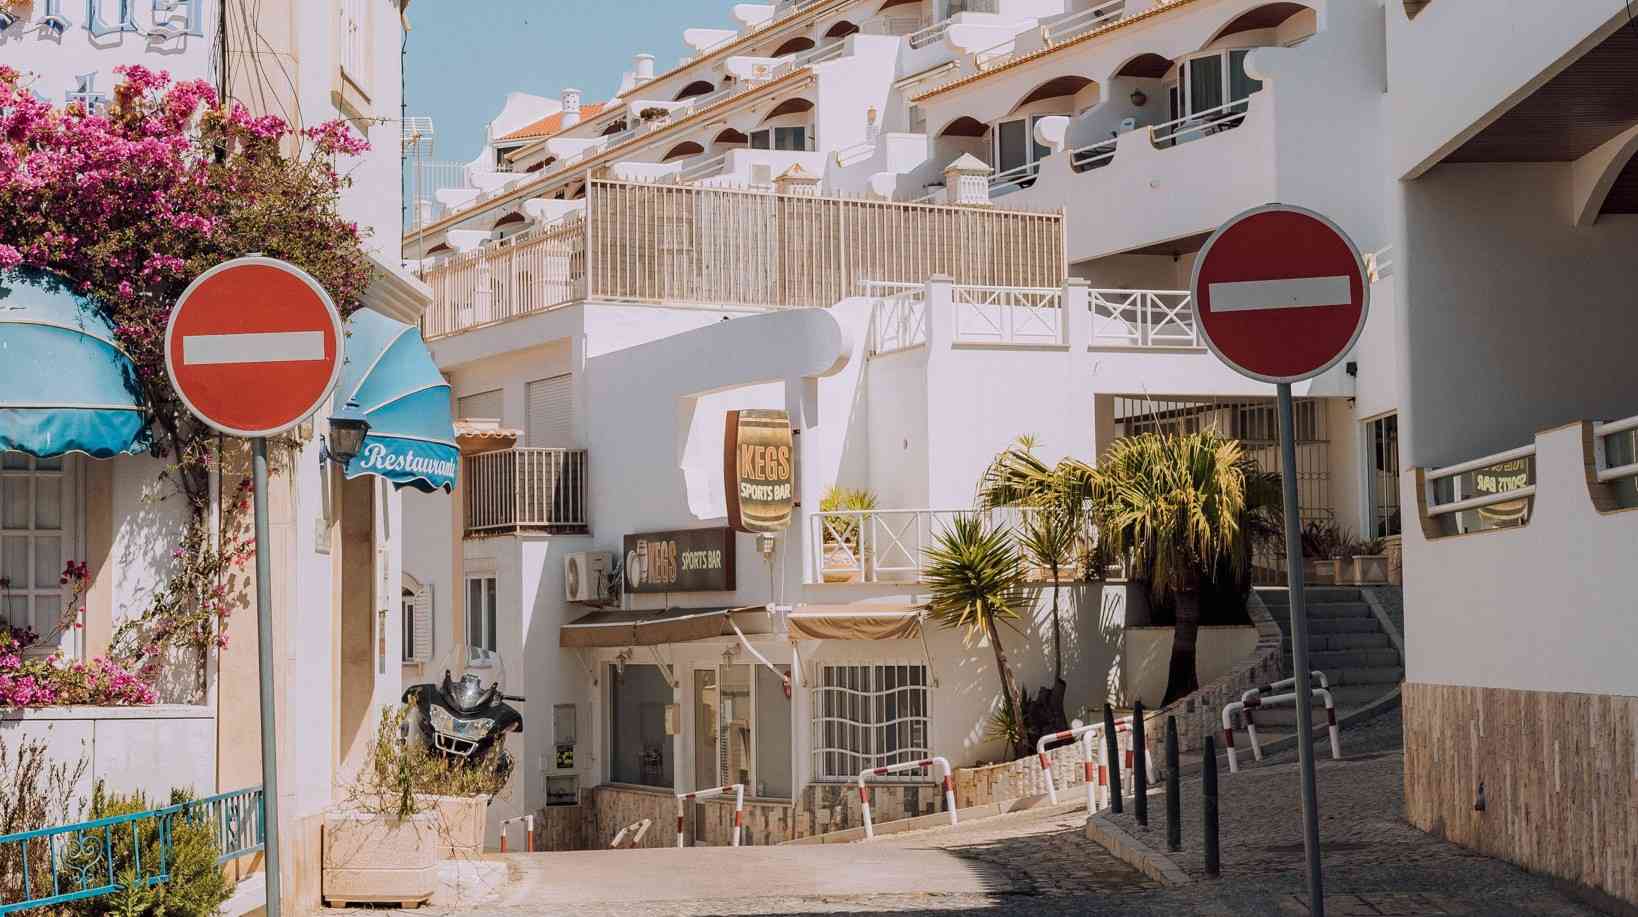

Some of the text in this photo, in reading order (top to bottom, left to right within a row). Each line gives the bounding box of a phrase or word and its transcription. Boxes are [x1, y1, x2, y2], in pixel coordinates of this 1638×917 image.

[741, 443, 790, 480] KEGS
[741, 482, 791, 500] SPORTS BAR
[647, 540, 722, 584] KEGS SPORTS BAR
